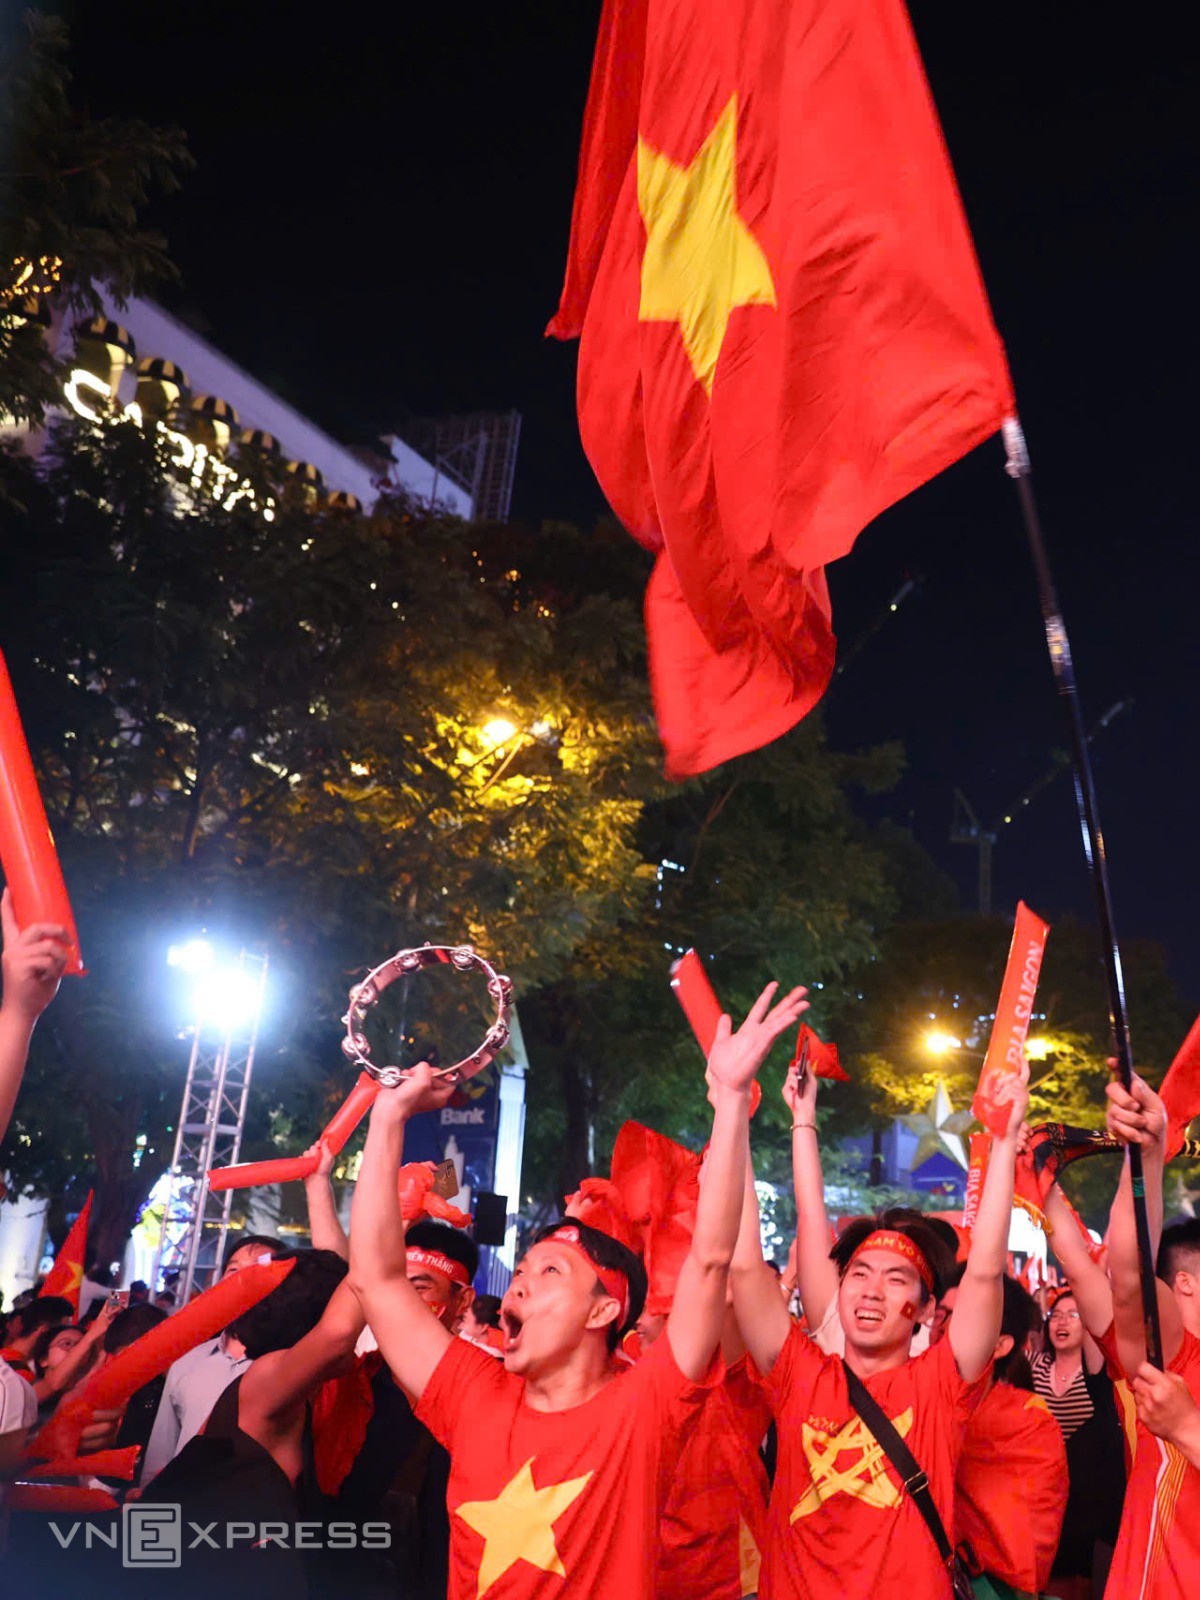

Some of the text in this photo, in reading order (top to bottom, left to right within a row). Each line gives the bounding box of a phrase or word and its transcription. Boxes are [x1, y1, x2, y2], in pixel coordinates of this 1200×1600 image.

[1014, 940, 1044, 1020] SAIGON
[441, 1107, 485, 1125] Bank
[965, 1169, 981, 1227] BIA SAIG
[864, 1237, 895, 1247] NAM
